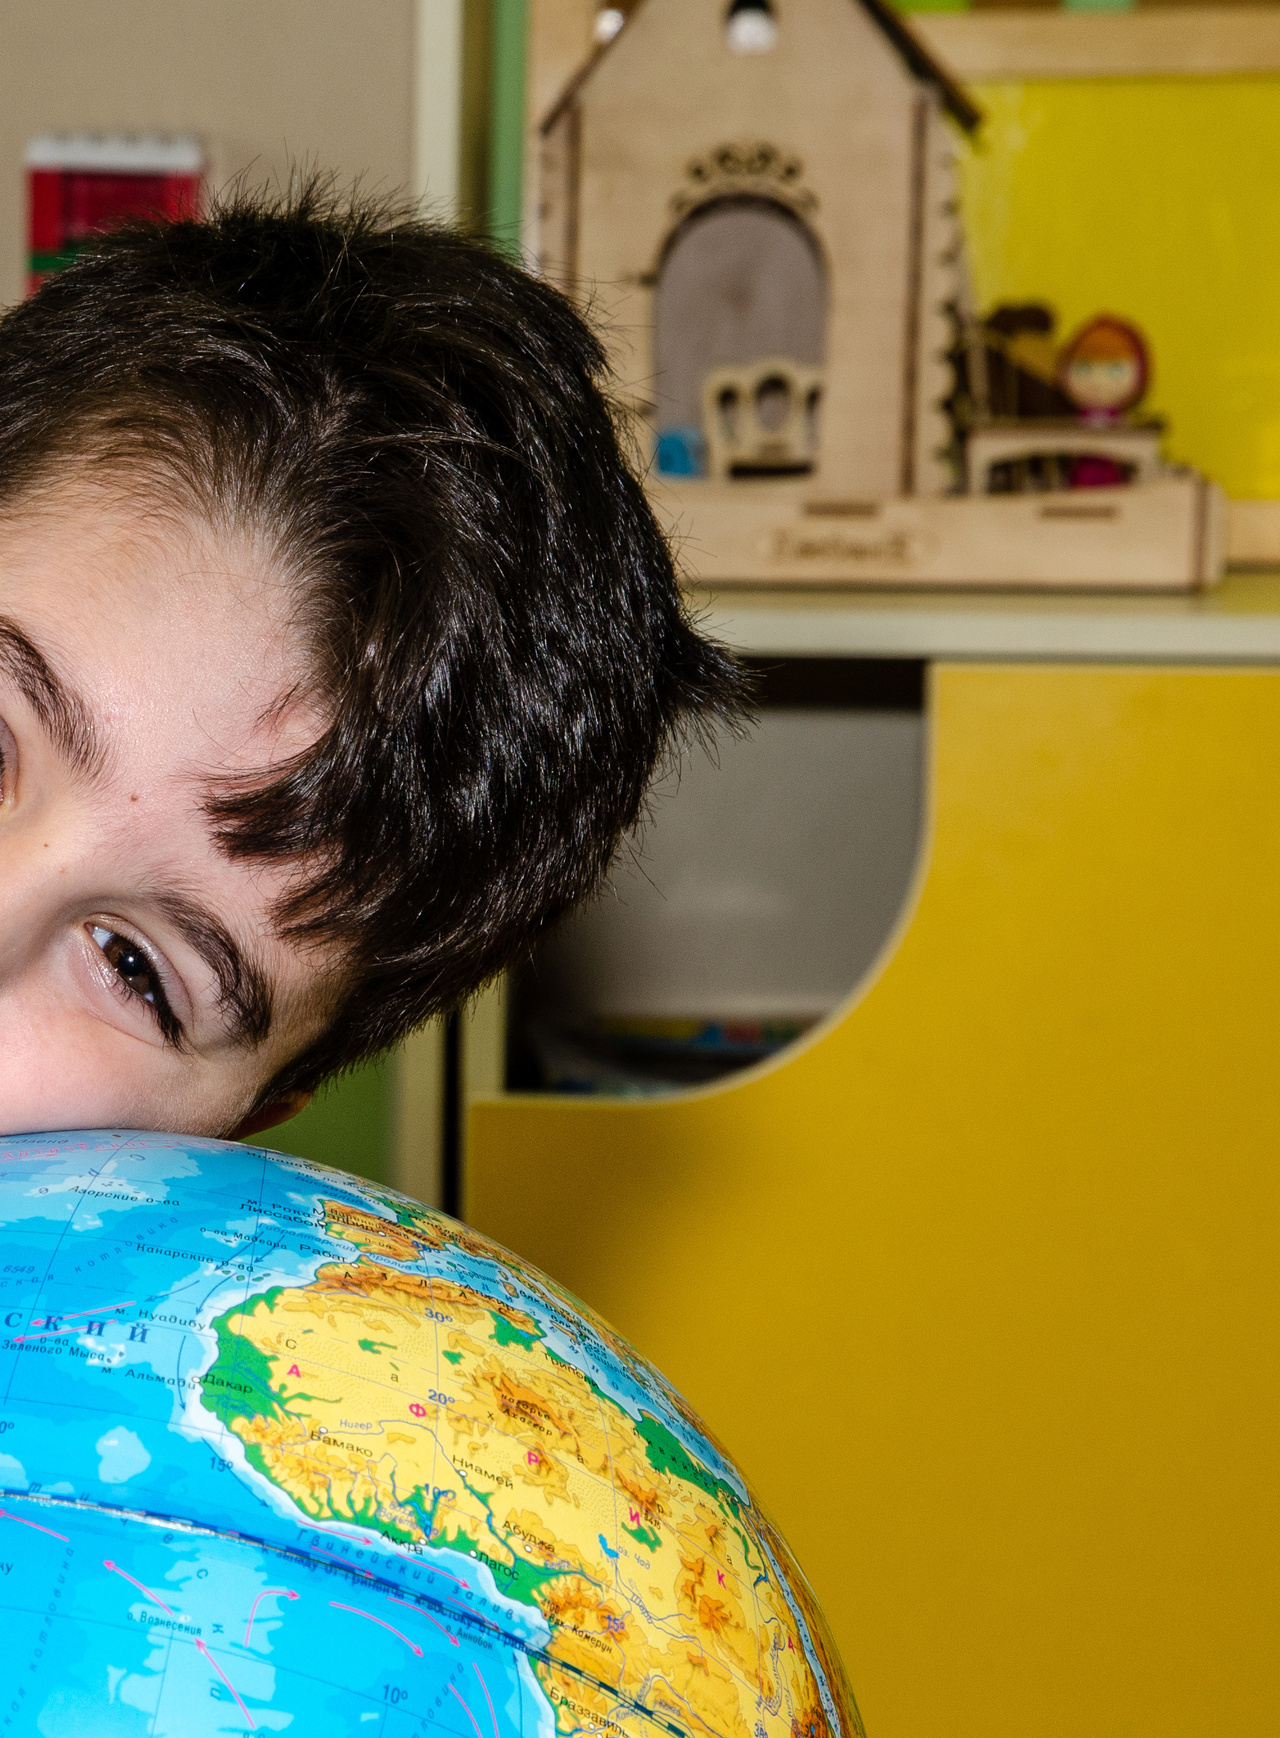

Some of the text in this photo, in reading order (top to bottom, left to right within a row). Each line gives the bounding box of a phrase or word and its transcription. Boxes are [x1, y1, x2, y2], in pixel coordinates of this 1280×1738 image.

[68, 1184, 180, 1206] Азорские о-ва
[239, 1203, 326, 1230] Лиссабон
[247, 1198, 312, 1219] м. Рока
[312, 1207, 375, 1233] Мадрид
[200, 1227, 288, 1250] о-ва Мадейра
[258, 1222, 413, 1270] Гибралтарский пролив
[137, 1243, 254, 1272] Канарские о-ва
[299, 1243, 348, 1263] Рабат
[3, 1264, 35, 1274] 6549
[465, 1283, 515, 1312] Алжир
[115, 1307, 207, 1331] м. Нуадибу
[423, 1307, 454, 1324] 30°
[2, 1340, 106, 1361] Зеленого Мыса
[40, 1337, 69, 1347] о-ва
[102, 1367, 196, 1390] м. Альмади
[541, 1351, 598, 1388] Триполи
[203, 1374, 252, 1393] Дакар
[427, 1390, 456, 1406] 20°
[501, 1393, 551, 1420] нагорье
[339, 1419, 373, 1431] Нигер
[503, 1408, 553, 1437] Ахаггар
[310, 1431, 374, 1458] Бамако
[209, 1456, 234, 1472] 15°
[452, 1454, 514, 1490] Ниамей
[381, 1530, 423, 1556] Аккра
[503, 1520, 556, 1554] Абуджа
[479, 1552, 520, 1582] Лагос
[618, 1547, 651, 1570] оз. Чад
[297, 1529, 514, 1620] Гвинейский залив
[127, 1610, 202, 1637] о. Вознесения
[457, 1626, 494, 1651] Аннобон
[572, 1624, 613, 1653] Камерун
[382, 1684, 408, 1706] 10°
[549, 1686, 630, 1738] Браззавиль
